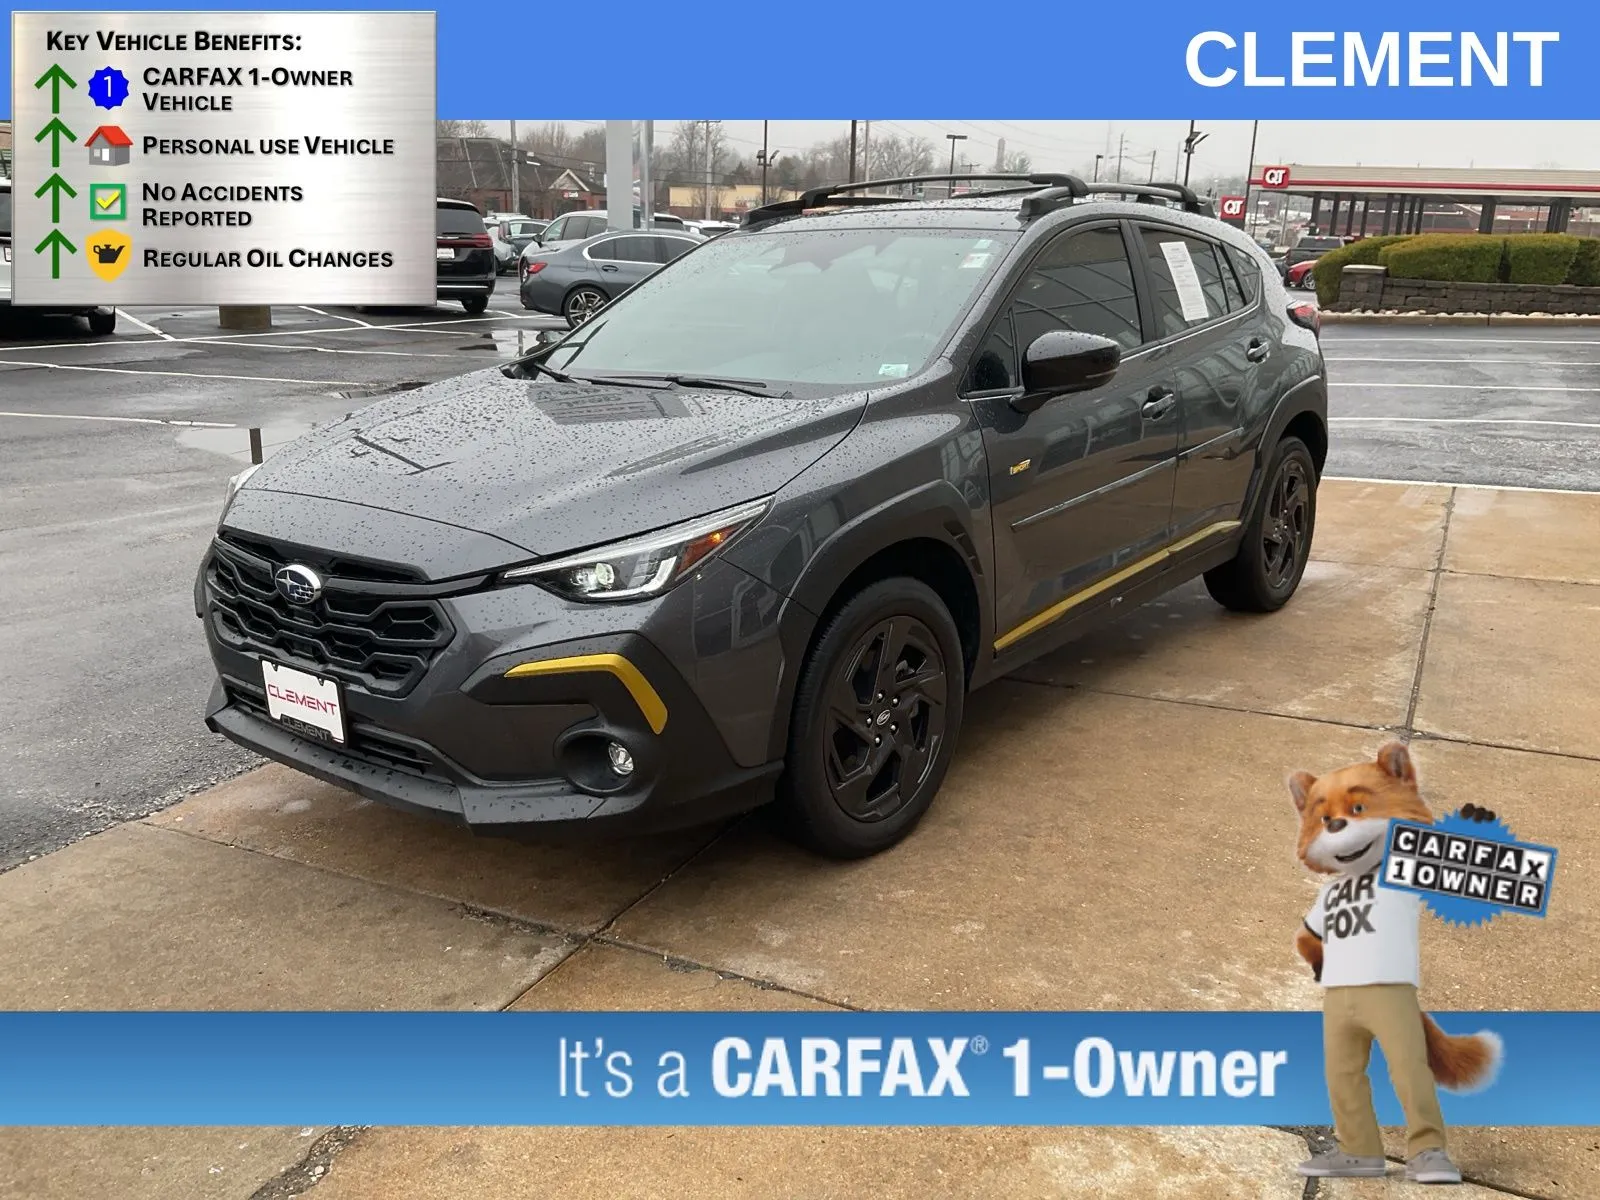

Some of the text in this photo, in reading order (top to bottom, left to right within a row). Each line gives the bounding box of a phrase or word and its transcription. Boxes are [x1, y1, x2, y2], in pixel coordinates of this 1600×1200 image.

[1265, 169, 1286, 185] QT
[1223, 199, 1245, 215] QT
[267, 683, 338, 716] CLEMENT
[281, 715, 330, 741] CLEMENT
